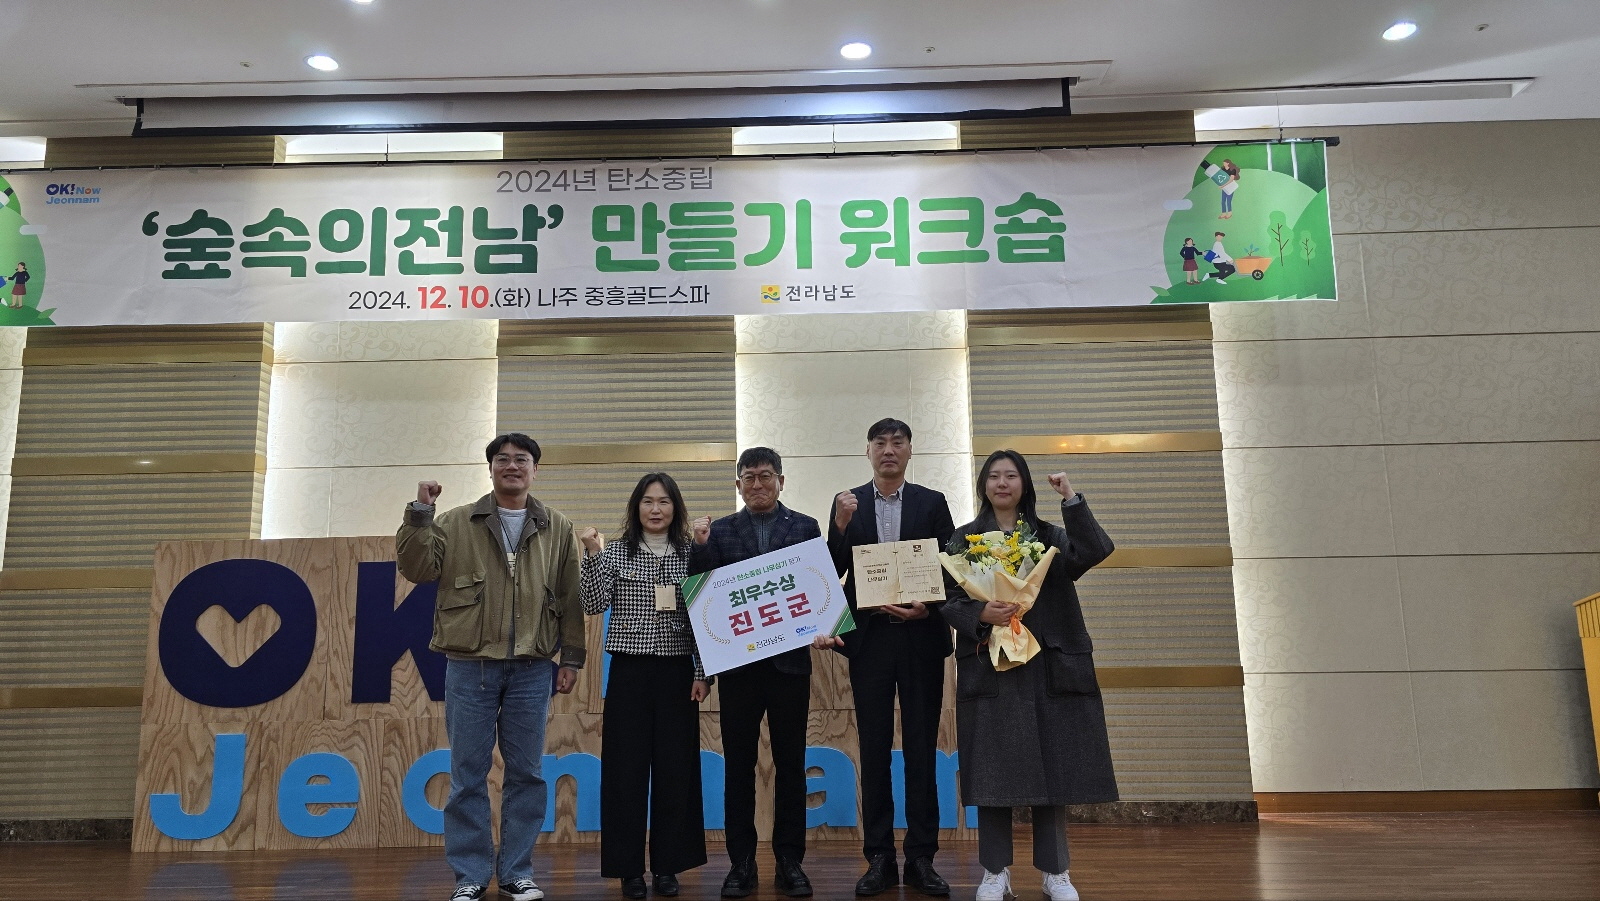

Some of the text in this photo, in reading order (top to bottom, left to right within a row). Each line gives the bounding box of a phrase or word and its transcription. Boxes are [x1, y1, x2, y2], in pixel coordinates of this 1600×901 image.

[46, 183, 101, 196] OK! Now
[496, 166, 713, 193] 2024년 탄소중립
[46, 196, 101, 205] Jeonnam
[591, 198, 813, 273] 만들기
[839, 191, 1067, 269] 워크숍
[348, 290, 411, 310] 2024.
[417, 285, 452, 310] 12.
[538, 287, 578, 308] 나주
[584, 285, 711, 307] 중흥골드스파
[785, 284, 857, 302] 전라남도
[712, 576, 737, 589] 2024년
[736, 566, 763, 582] 탄소중립
[762, 560, 788, 574] 나무심기
[728, 573, 797, 609] 최우수상
[159, 557, 559, 708] OK
[756, 633, 786, 649] 전라남도
